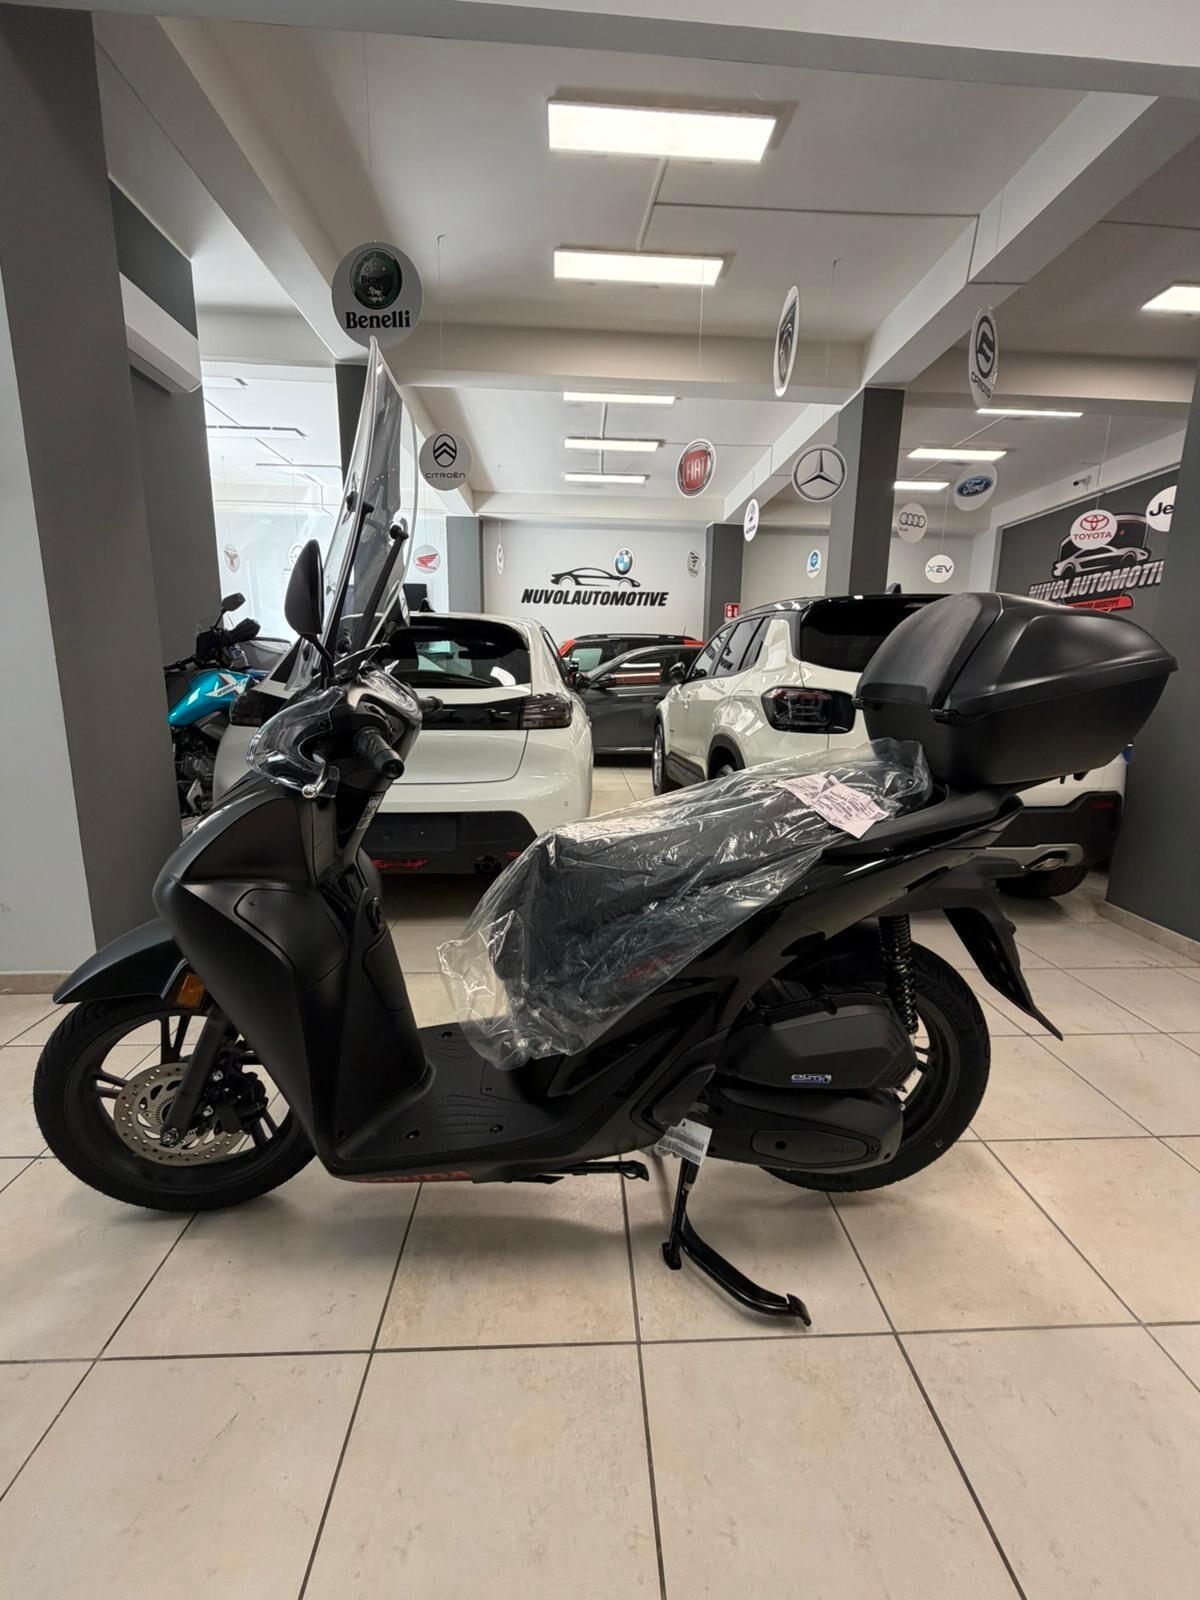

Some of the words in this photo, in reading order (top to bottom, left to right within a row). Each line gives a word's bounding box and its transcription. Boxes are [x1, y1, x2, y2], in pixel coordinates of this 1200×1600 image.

[345, 310, 411, 329] Benelli
[686, 456, 706, 482] FIAT
[962, 479, 986, 496] Ford
[1073, 531, 1113, 541] TOYOTA
[927, 564, 953, 574] XEV
[521, 588, 670, 607] NUVOLAUTOMOTIVE
